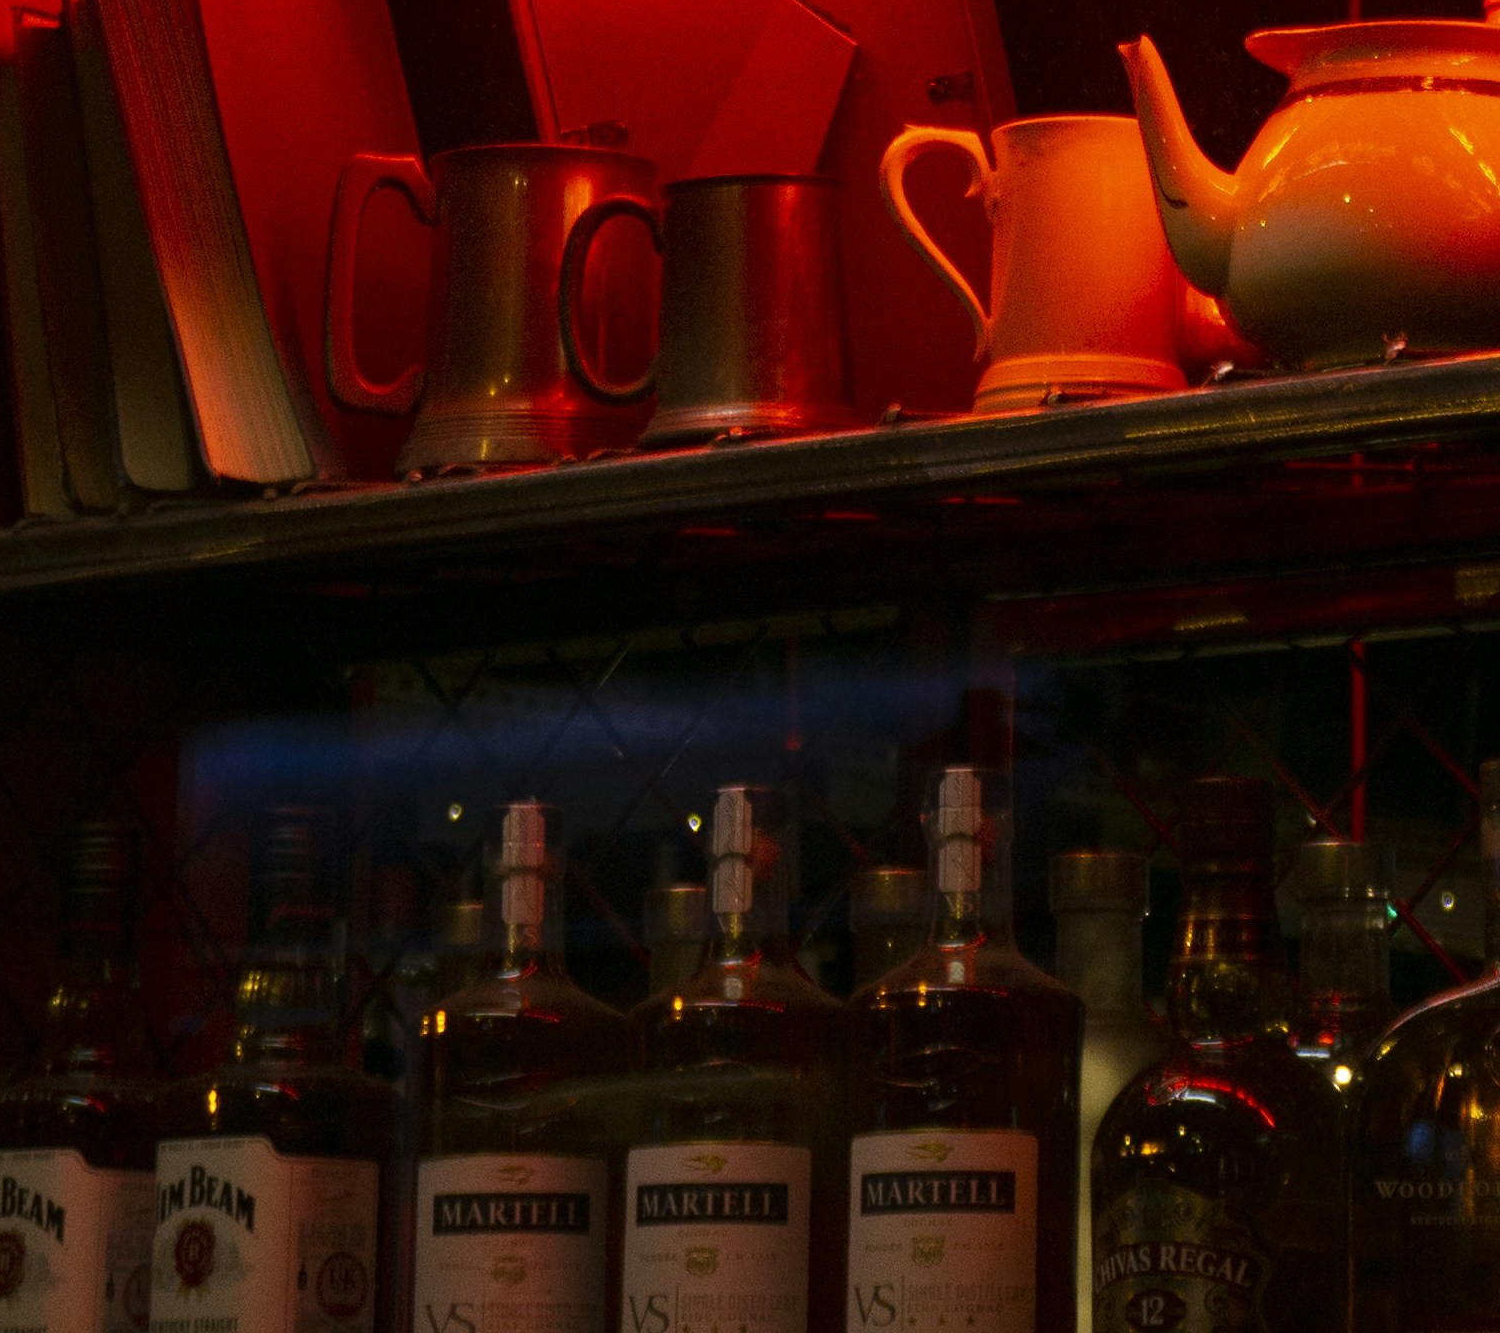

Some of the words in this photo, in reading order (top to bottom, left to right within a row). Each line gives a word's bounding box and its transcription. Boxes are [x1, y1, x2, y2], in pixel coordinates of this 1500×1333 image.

[156, 1178, 185, 1225] IM
[188, 1164, 257, 1233] BEAM
[642, 1187, 778, 1218] MARTELL
[866, 1178, 1005, 1207] MARTELL
[1, 1176, 65, 1246] BEAM
[440, 1196, 579, 1227] MARTELL
[1160, 1244, 1252, 1287] REGAL
[425, 1302, 477, 1333] VS
[629, 1293, 670, 1333] VS
[853, 1282, 897, 1328] VS
[1141, 1295, 1166, 1327] 12
